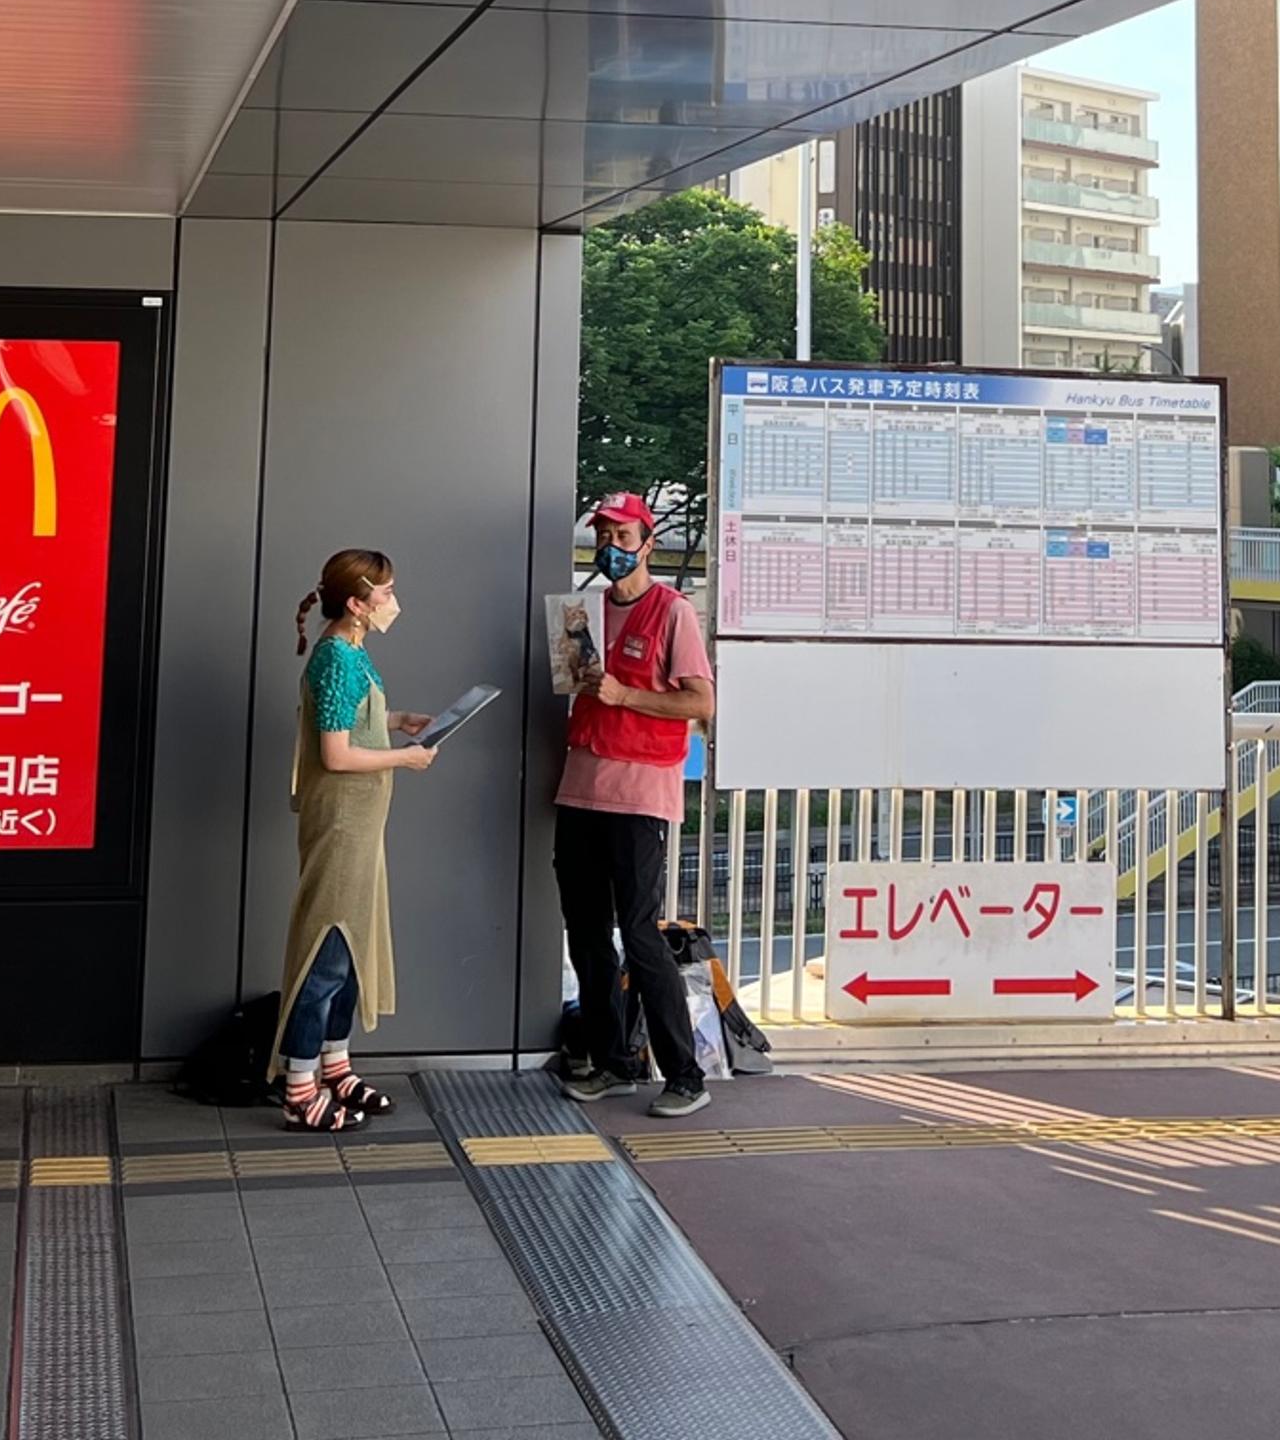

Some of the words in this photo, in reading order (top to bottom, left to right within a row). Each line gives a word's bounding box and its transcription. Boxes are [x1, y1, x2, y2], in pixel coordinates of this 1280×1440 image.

[771, 374, 980, 401] 阪急バス発車予定時刻表
[1065, 393, 1116, 408] Hankyu
[1118, 394, 1144, 408] Bus
[1148, 395, 1211, 410] Timetable
[724, 520, 738, 563] 土休日
[839, 882, 1104, 941] エレベーター
